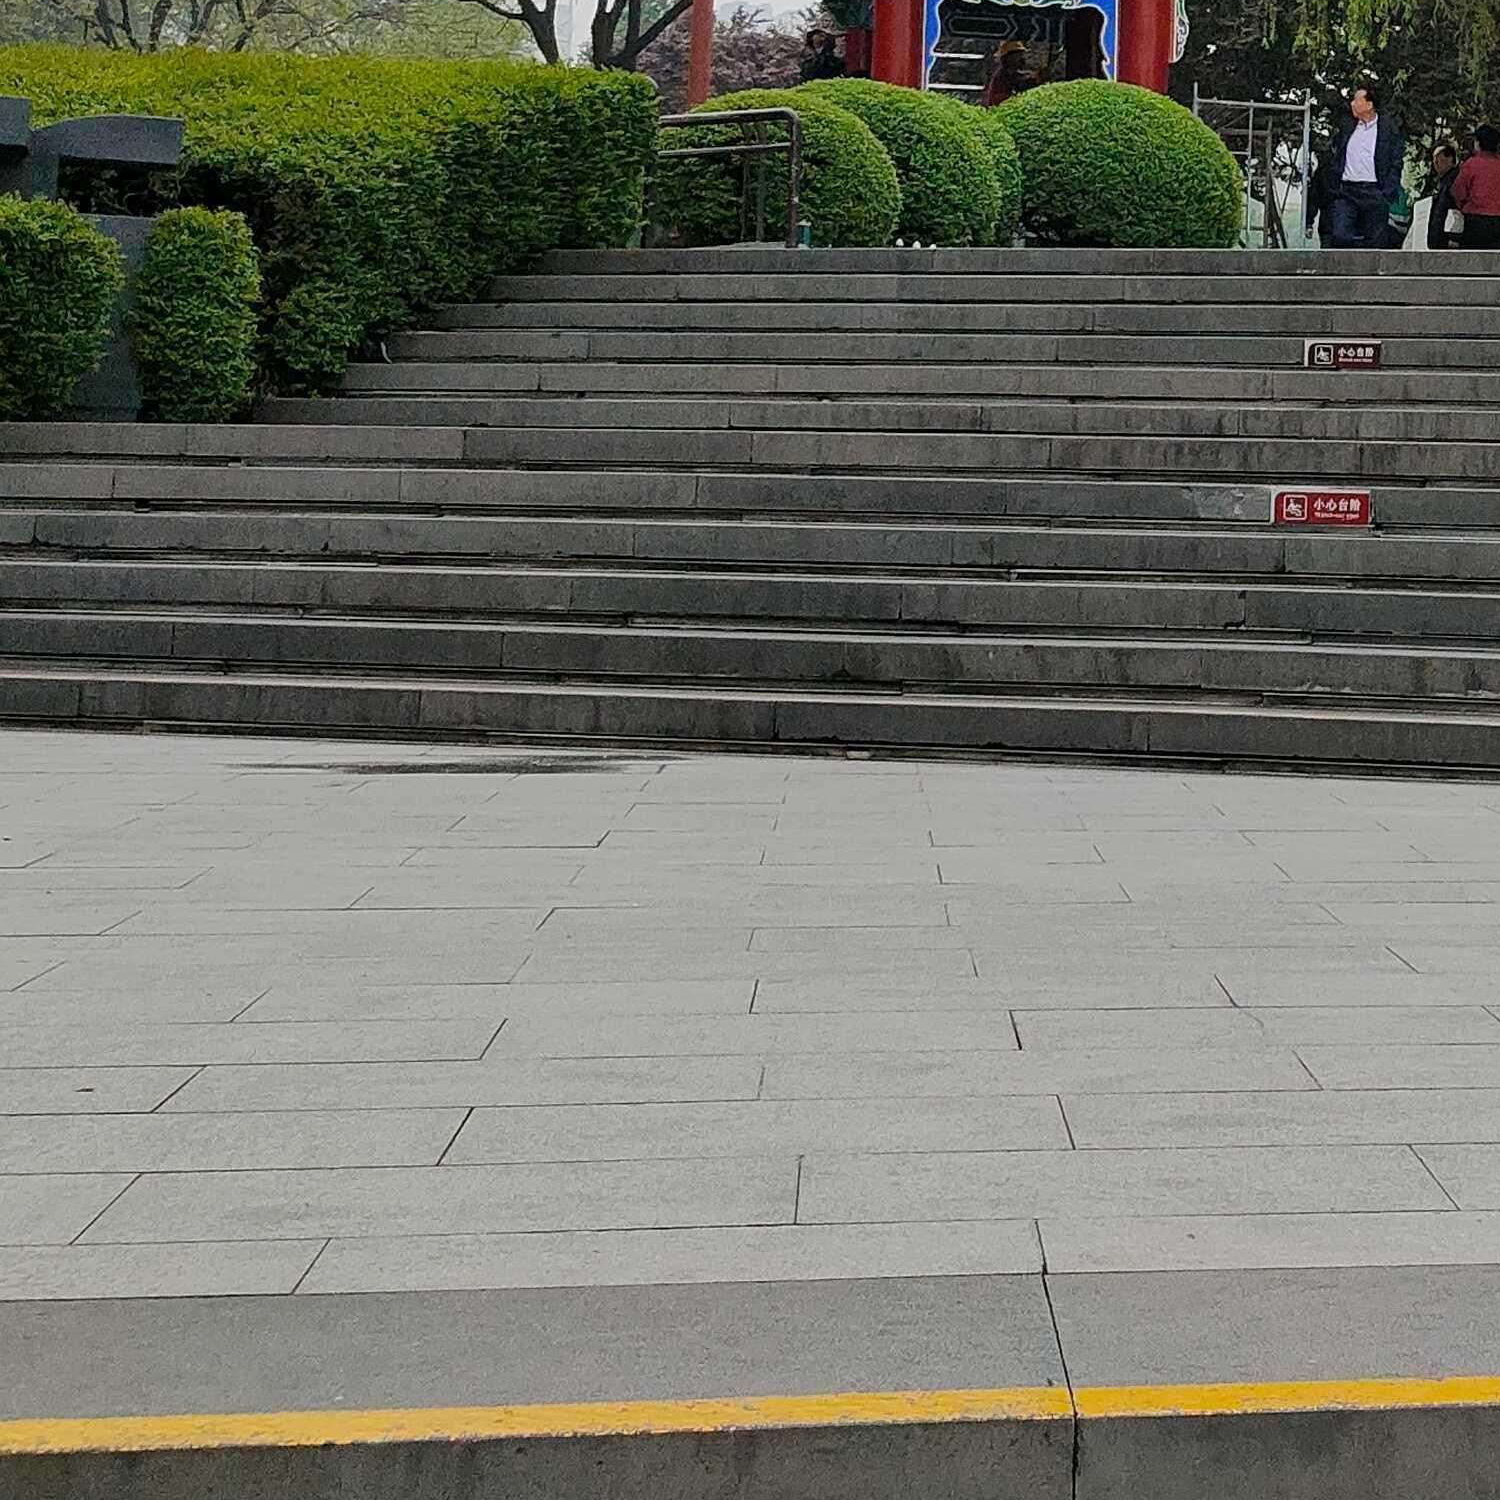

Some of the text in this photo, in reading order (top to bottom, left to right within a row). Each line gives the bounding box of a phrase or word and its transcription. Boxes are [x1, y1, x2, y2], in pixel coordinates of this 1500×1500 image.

[1337, 346, 1375, 357] 小心台阶
[1313, 497, 1361, 512] 小心台阶
